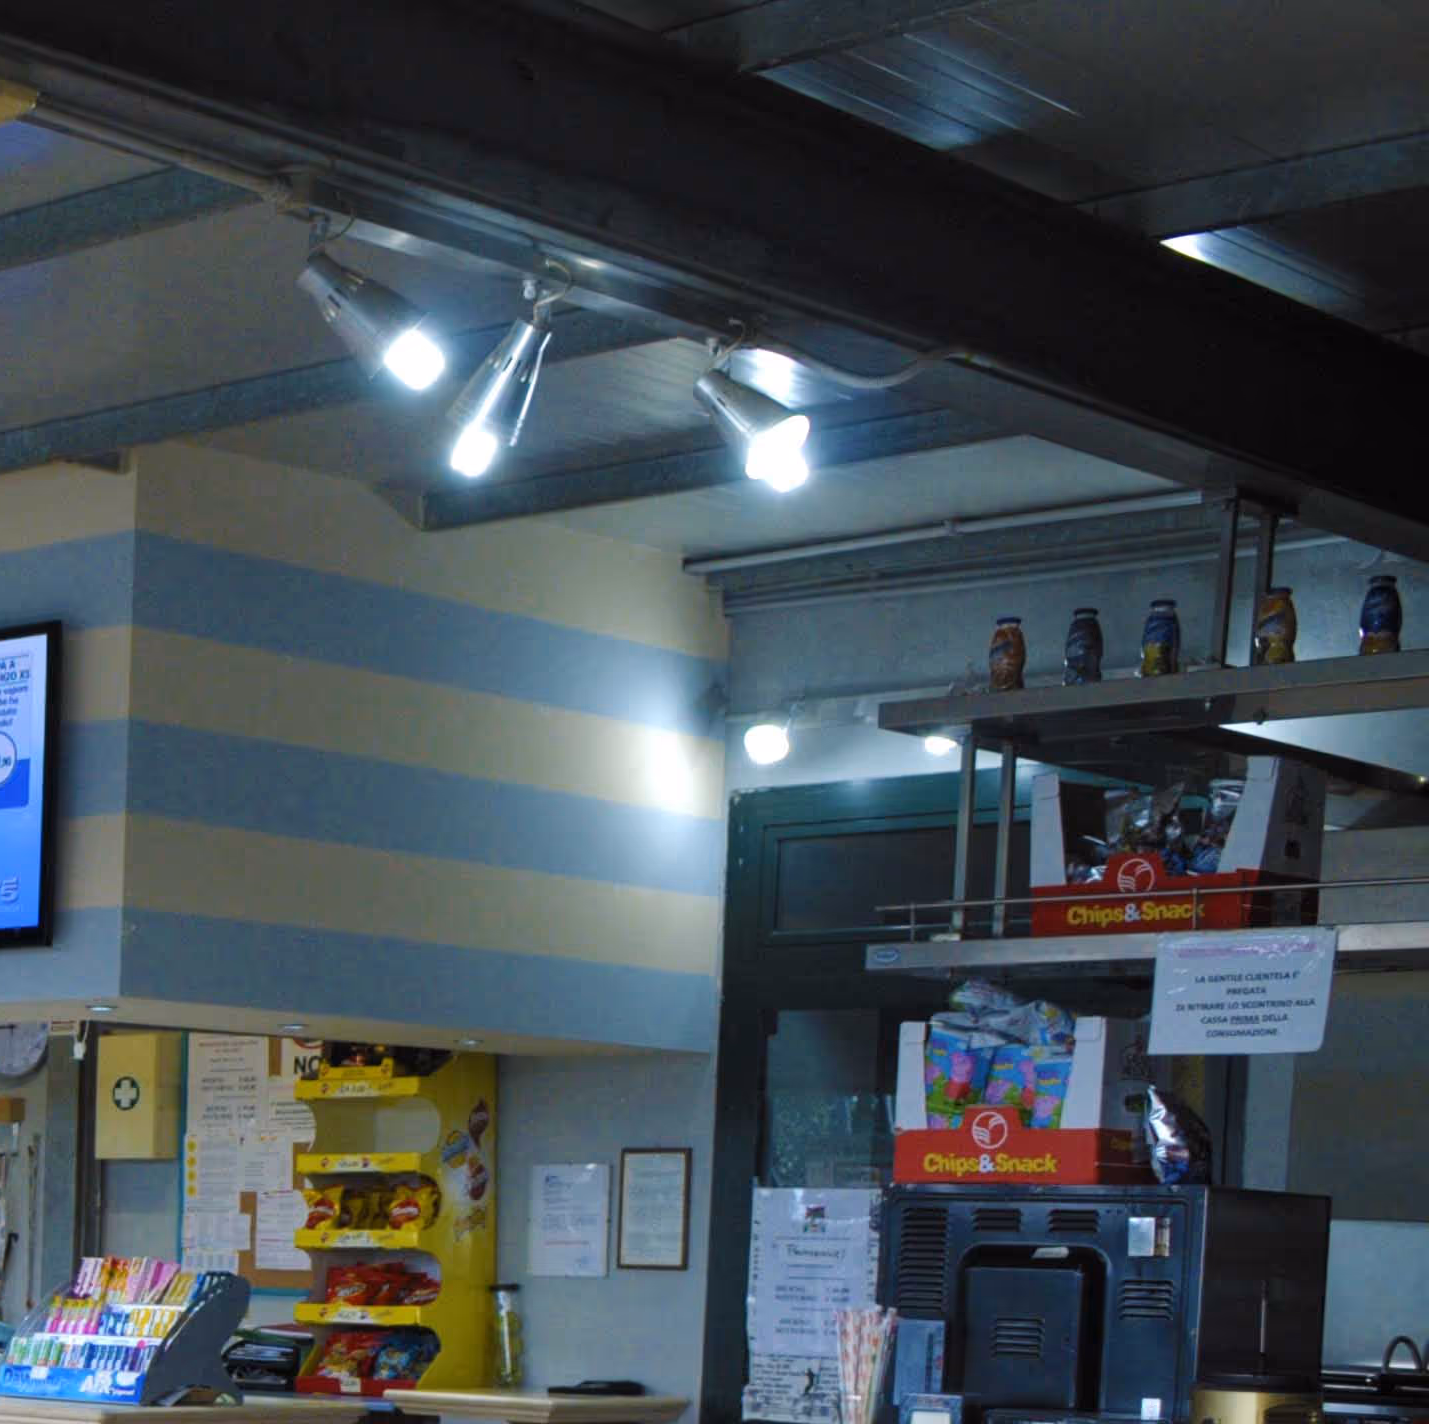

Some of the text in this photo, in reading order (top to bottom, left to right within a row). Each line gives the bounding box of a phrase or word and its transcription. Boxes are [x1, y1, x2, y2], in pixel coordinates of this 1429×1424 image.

[1067, 901, 1205, 928] Chips&Snack
[1208, 973, 1242, 984] GENTILE
[1244, 972, 1290, 983] CLIENTELA
[1200, 1015, 1228, 1025] CASSA
[923, 1153, 1058, 1177] Chips&Snack
